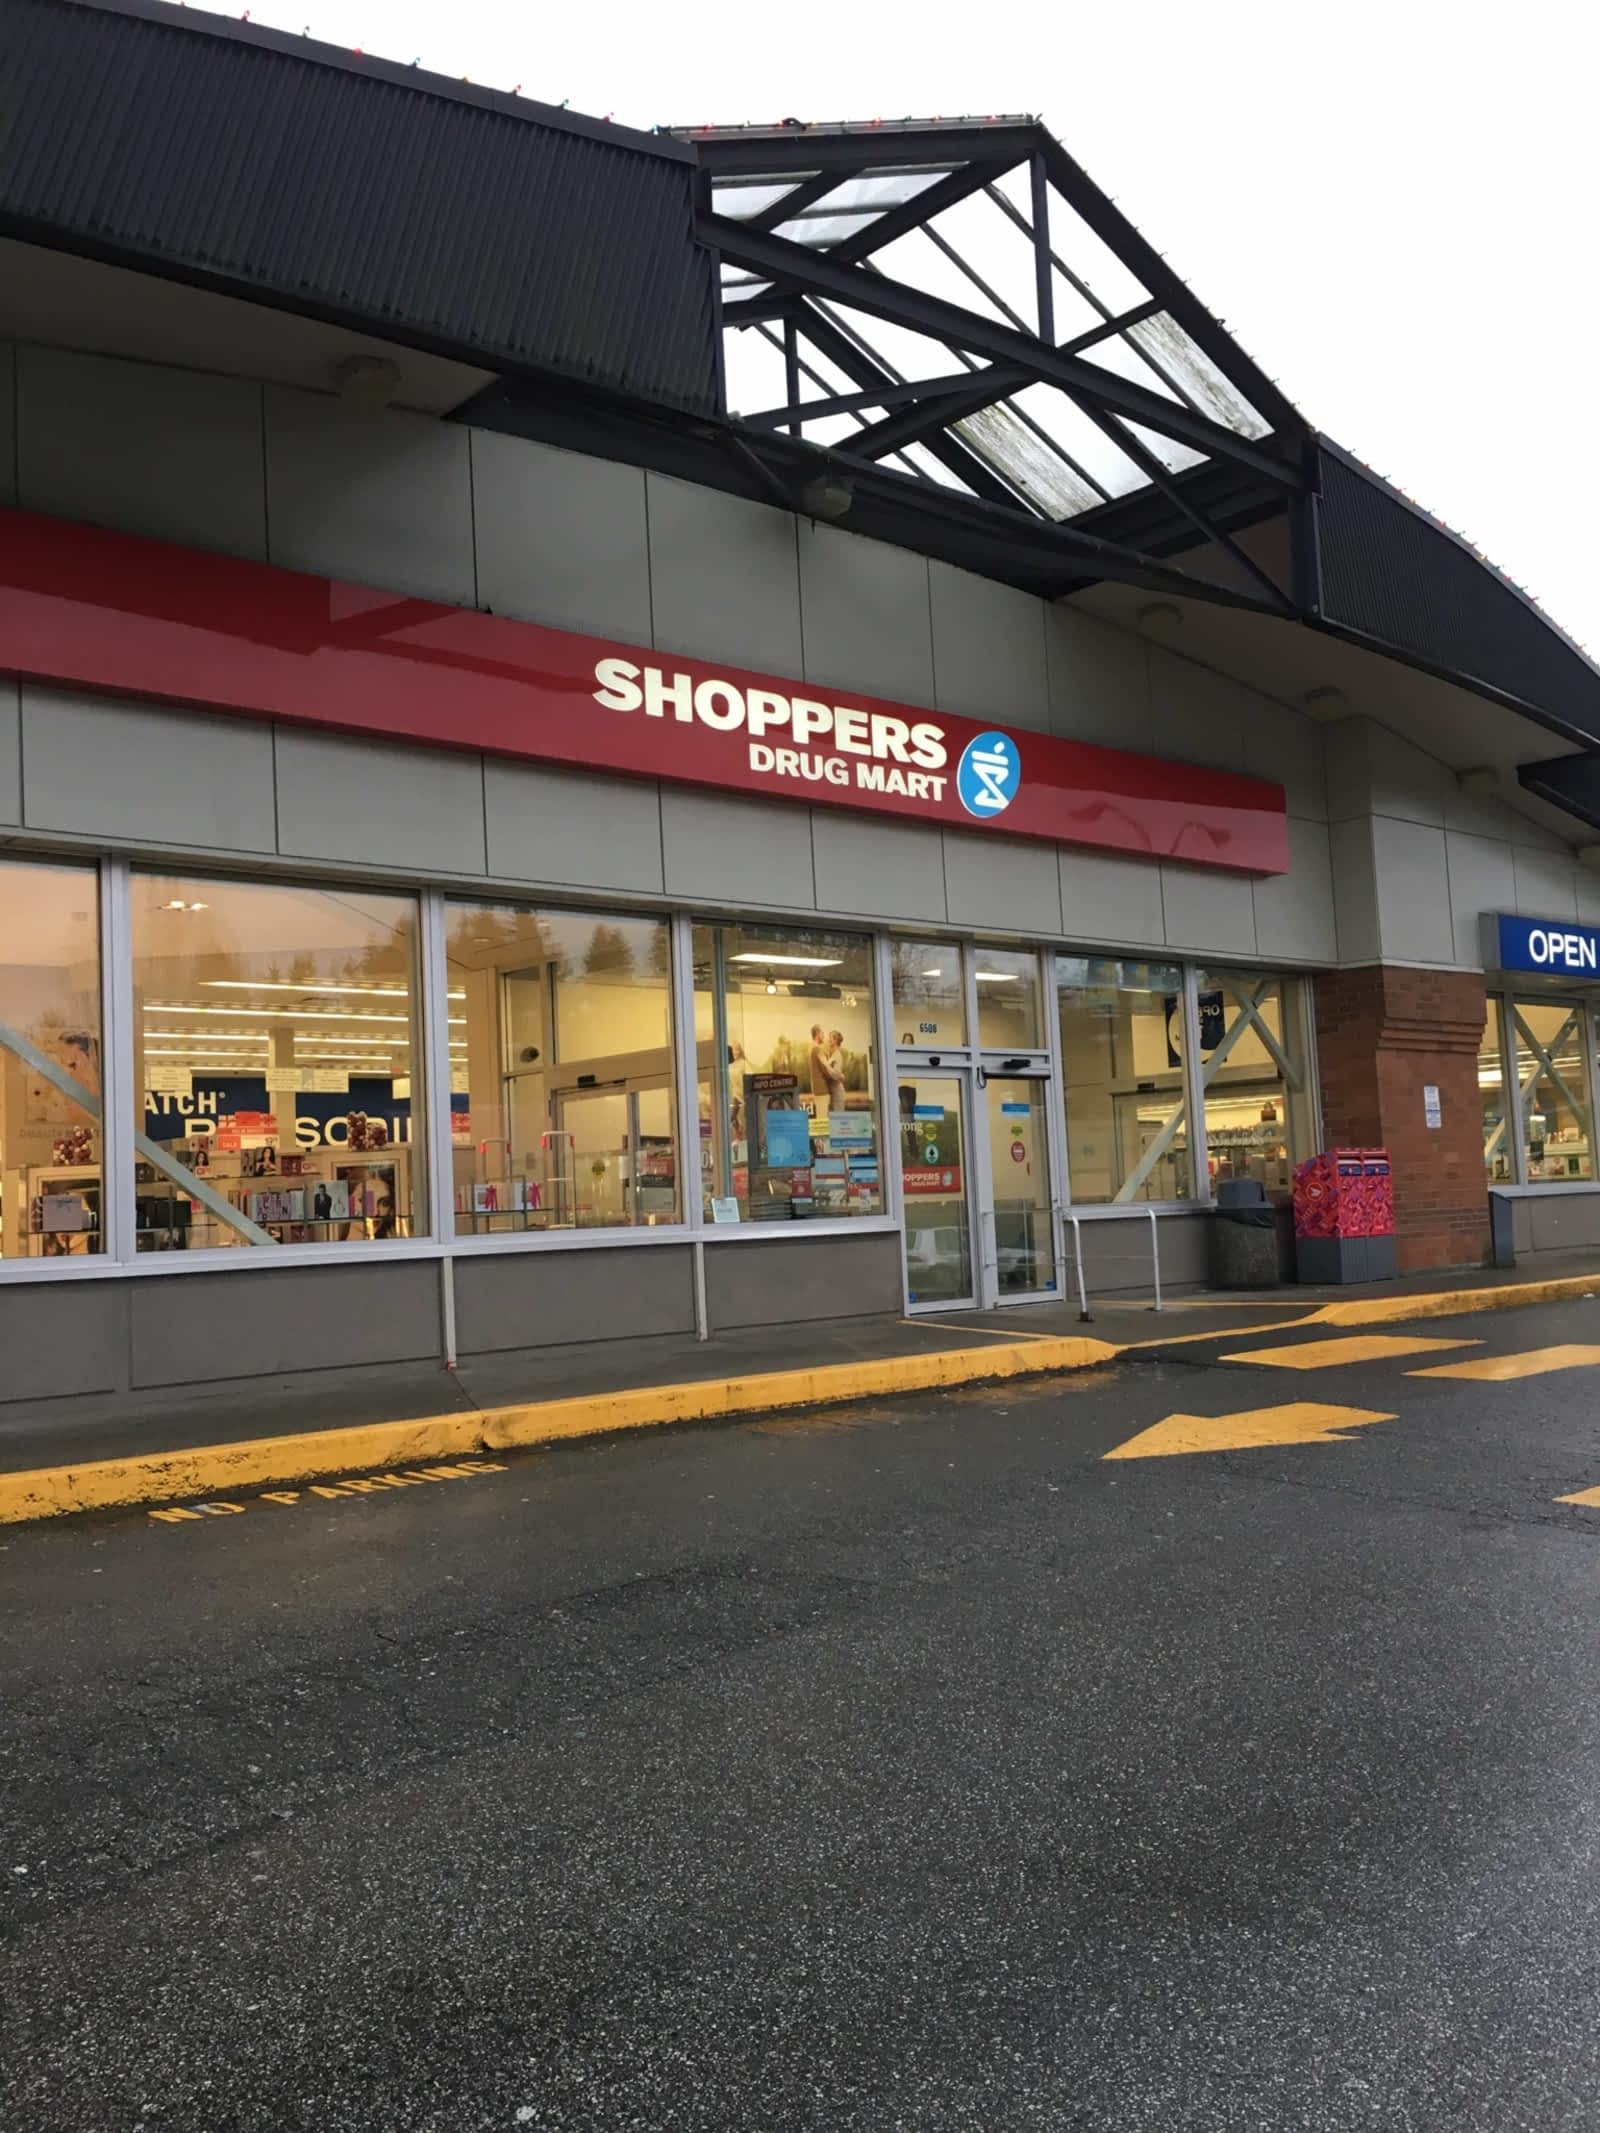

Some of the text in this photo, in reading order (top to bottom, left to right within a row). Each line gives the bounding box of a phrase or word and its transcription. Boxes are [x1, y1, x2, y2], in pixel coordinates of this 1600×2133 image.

[592, 658, 947, 769] SHOPPERS
[750, 744, 947, 803] DRUG MART
[1529, 929, 1597, 969] OPEN
[144, 1091, 217, 1115] ATCH
[147, 1463, 512, 1523] NO PARKING
